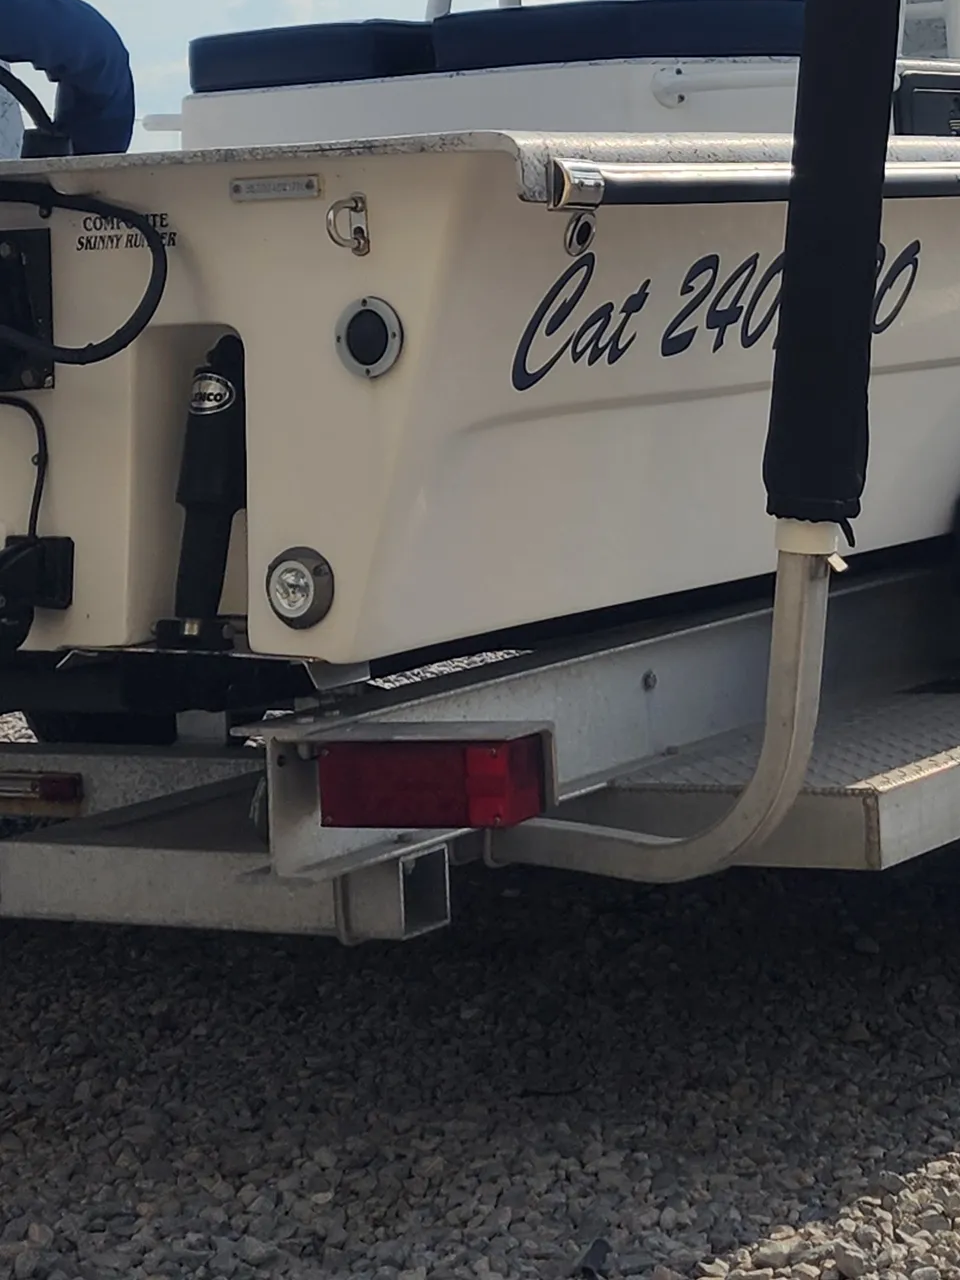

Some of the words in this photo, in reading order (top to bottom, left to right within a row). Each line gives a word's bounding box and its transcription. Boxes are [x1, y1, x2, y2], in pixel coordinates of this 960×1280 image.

[82, 213, 169, 232] COMTE
[76, 233, 123, 252] SKINNY
[511, 252, 651, 392] Cat
